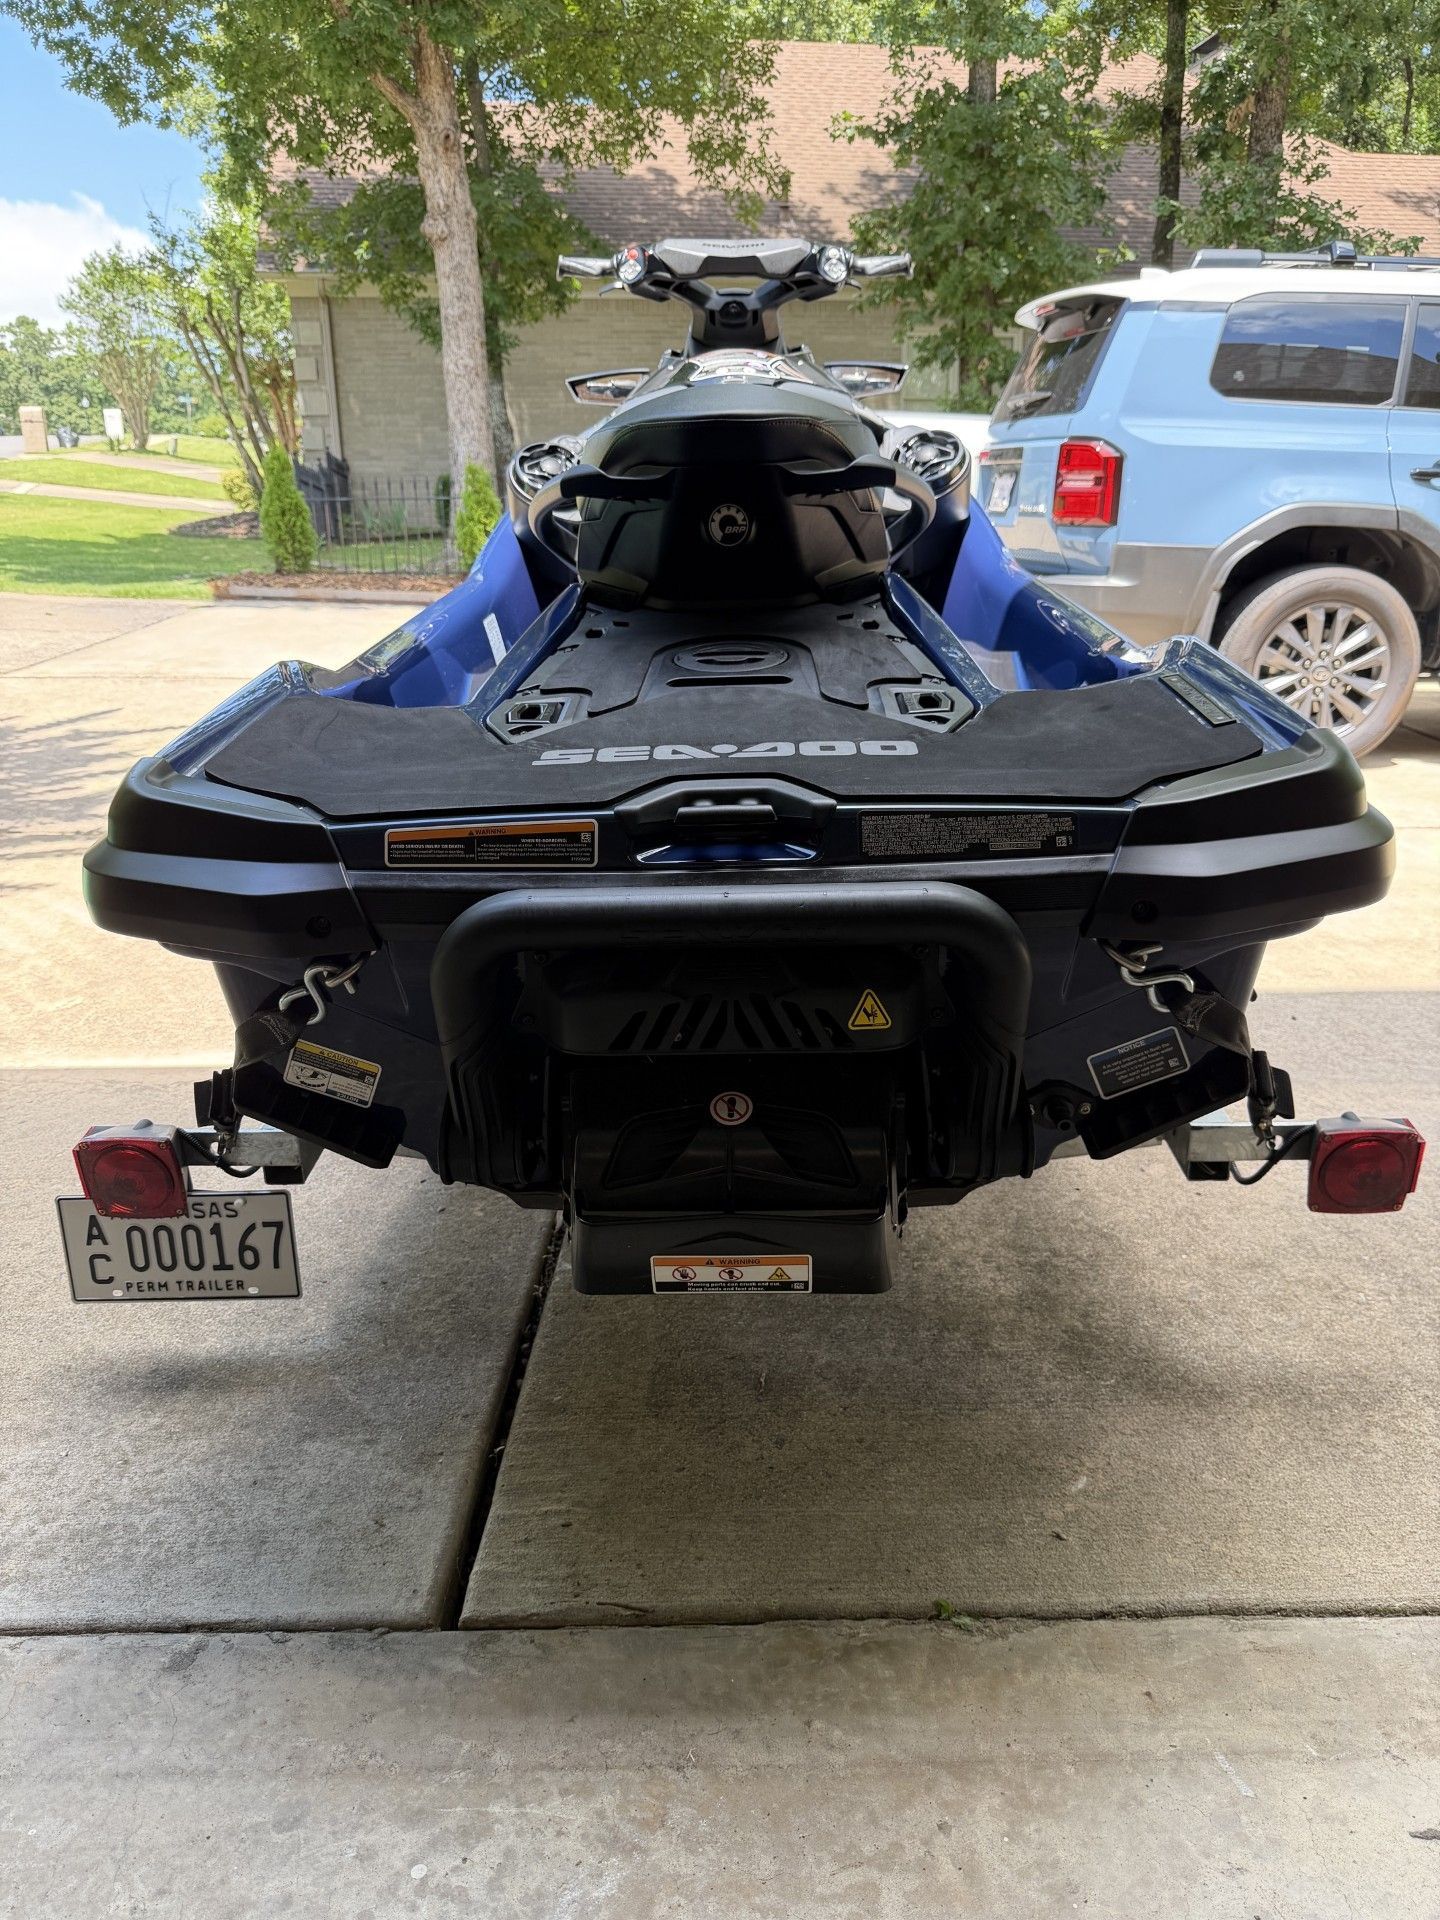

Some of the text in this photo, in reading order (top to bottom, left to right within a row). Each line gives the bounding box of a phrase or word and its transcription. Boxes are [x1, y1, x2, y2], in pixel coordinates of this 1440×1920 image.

[725, 526, 747, 534] BRP
[1118, 1040, 1146, 1054] NOTICE
[326, 1051, 359, 1066] CAUTION
[126, 1221, 284, 1273] 000167
[125, 1280, 245, 1293] PERM TRAILER
